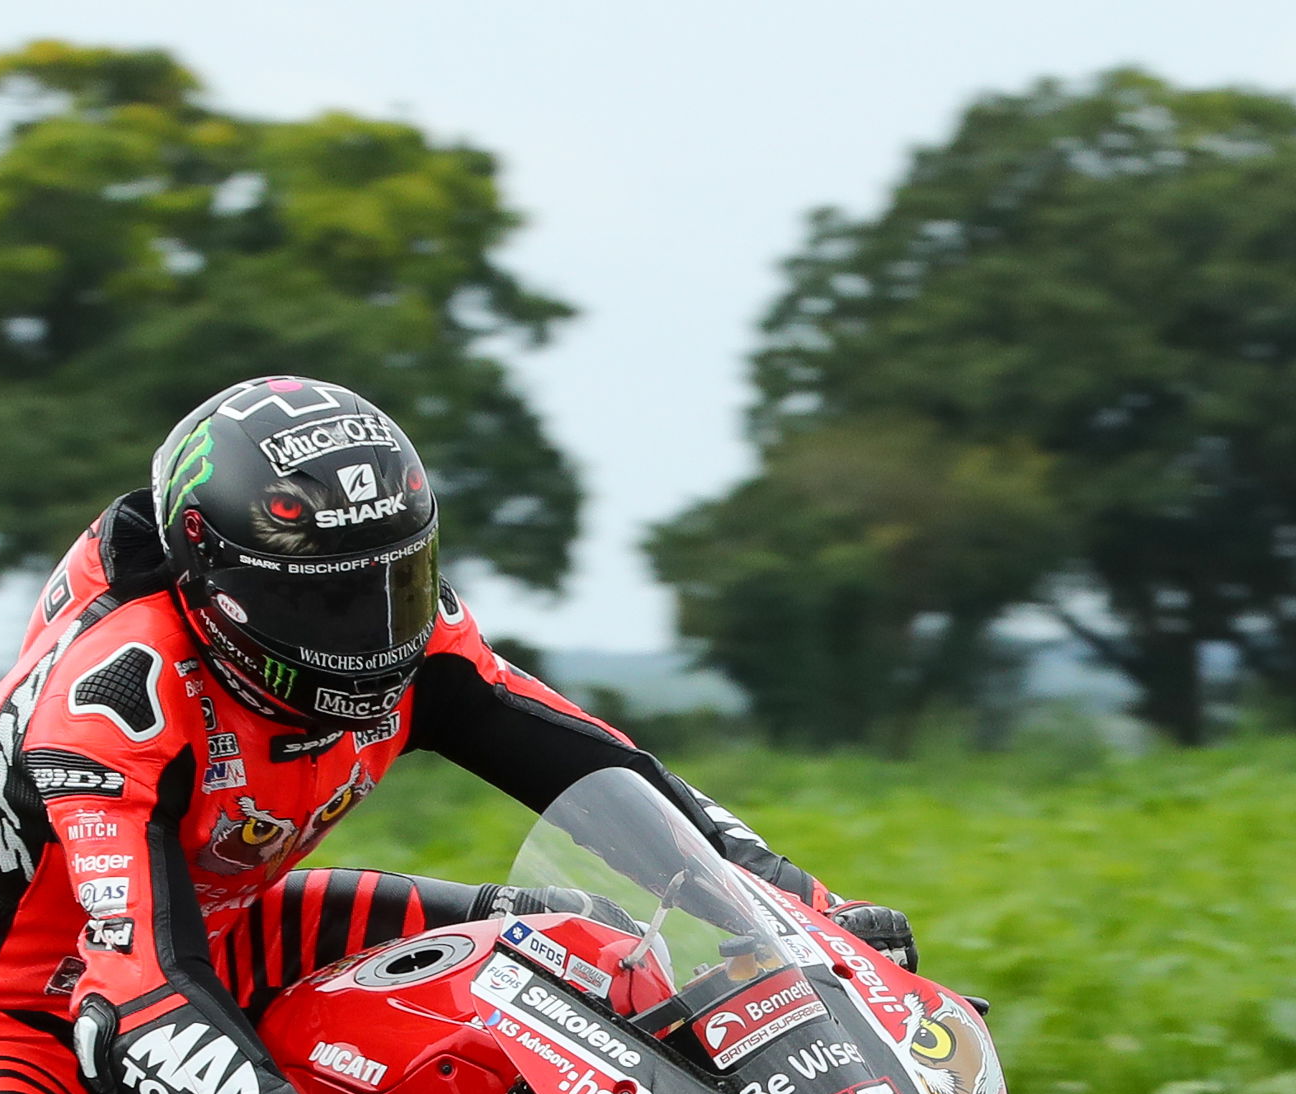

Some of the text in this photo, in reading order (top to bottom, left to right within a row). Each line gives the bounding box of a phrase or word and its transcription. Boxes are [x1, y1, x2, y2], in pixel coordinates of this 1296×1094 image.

[315, 493, 407, 529] SHARK
[239, 554, 281, 572] SHARK
[288, 559, 370, 574] BISCHOFF
[299, 647, 364, 671] WATCHES
[365, 656, 377, 670] of
[68, 823, 118, 840] MITCH
[487, 966, 522, 990] FUCHS
[521, 986, 641, 1068] Silkolene
[497, 1017, 575, 1074] KS Advisory
[720, 1030, 770, 1064] BRITISH
[309, 1041, 388, 1087] DUCATI
